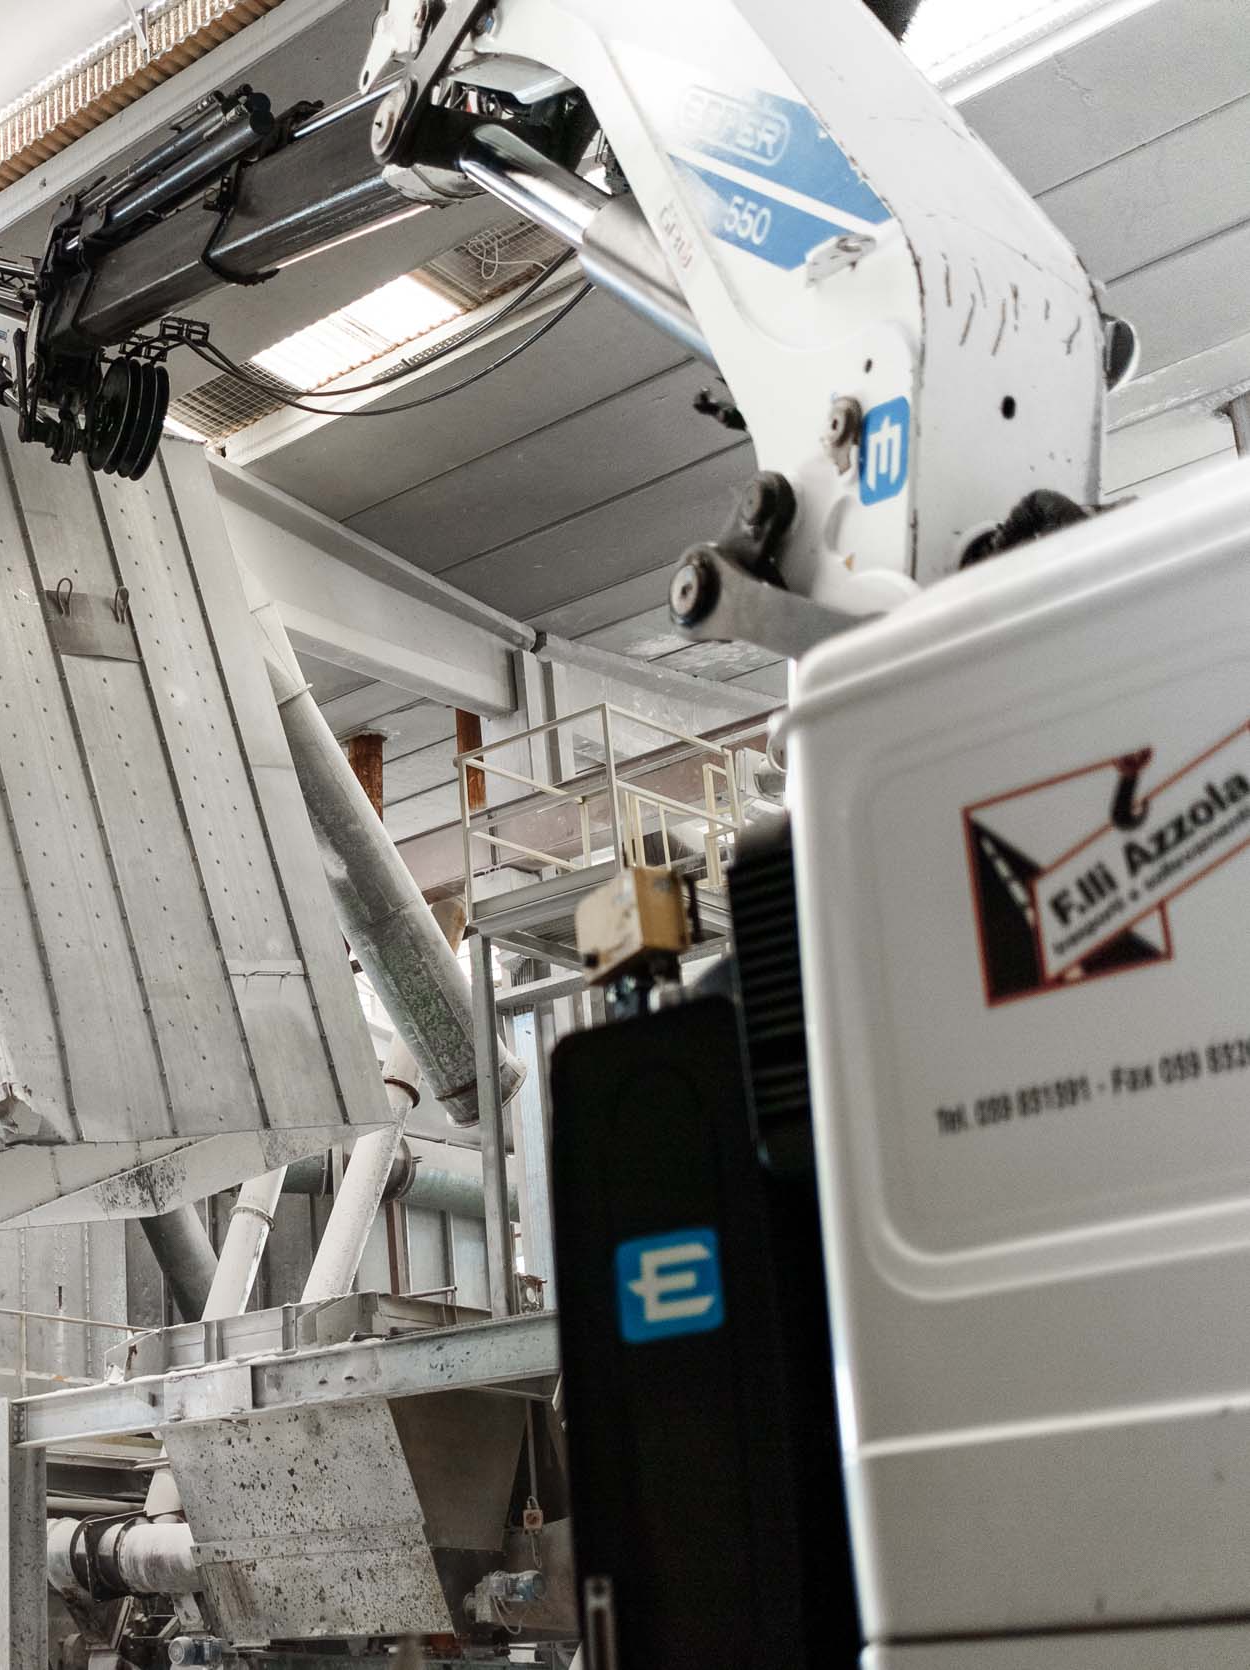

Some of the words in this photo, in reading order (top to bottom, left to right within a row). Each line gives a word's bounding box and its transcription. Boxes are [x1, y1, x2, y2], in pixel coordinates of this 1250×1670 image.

[724, 195, 772, 246] 550
[1123, 774, 1250, 877] Azzola
[1111, 1065, 1154, 1094] Fax
